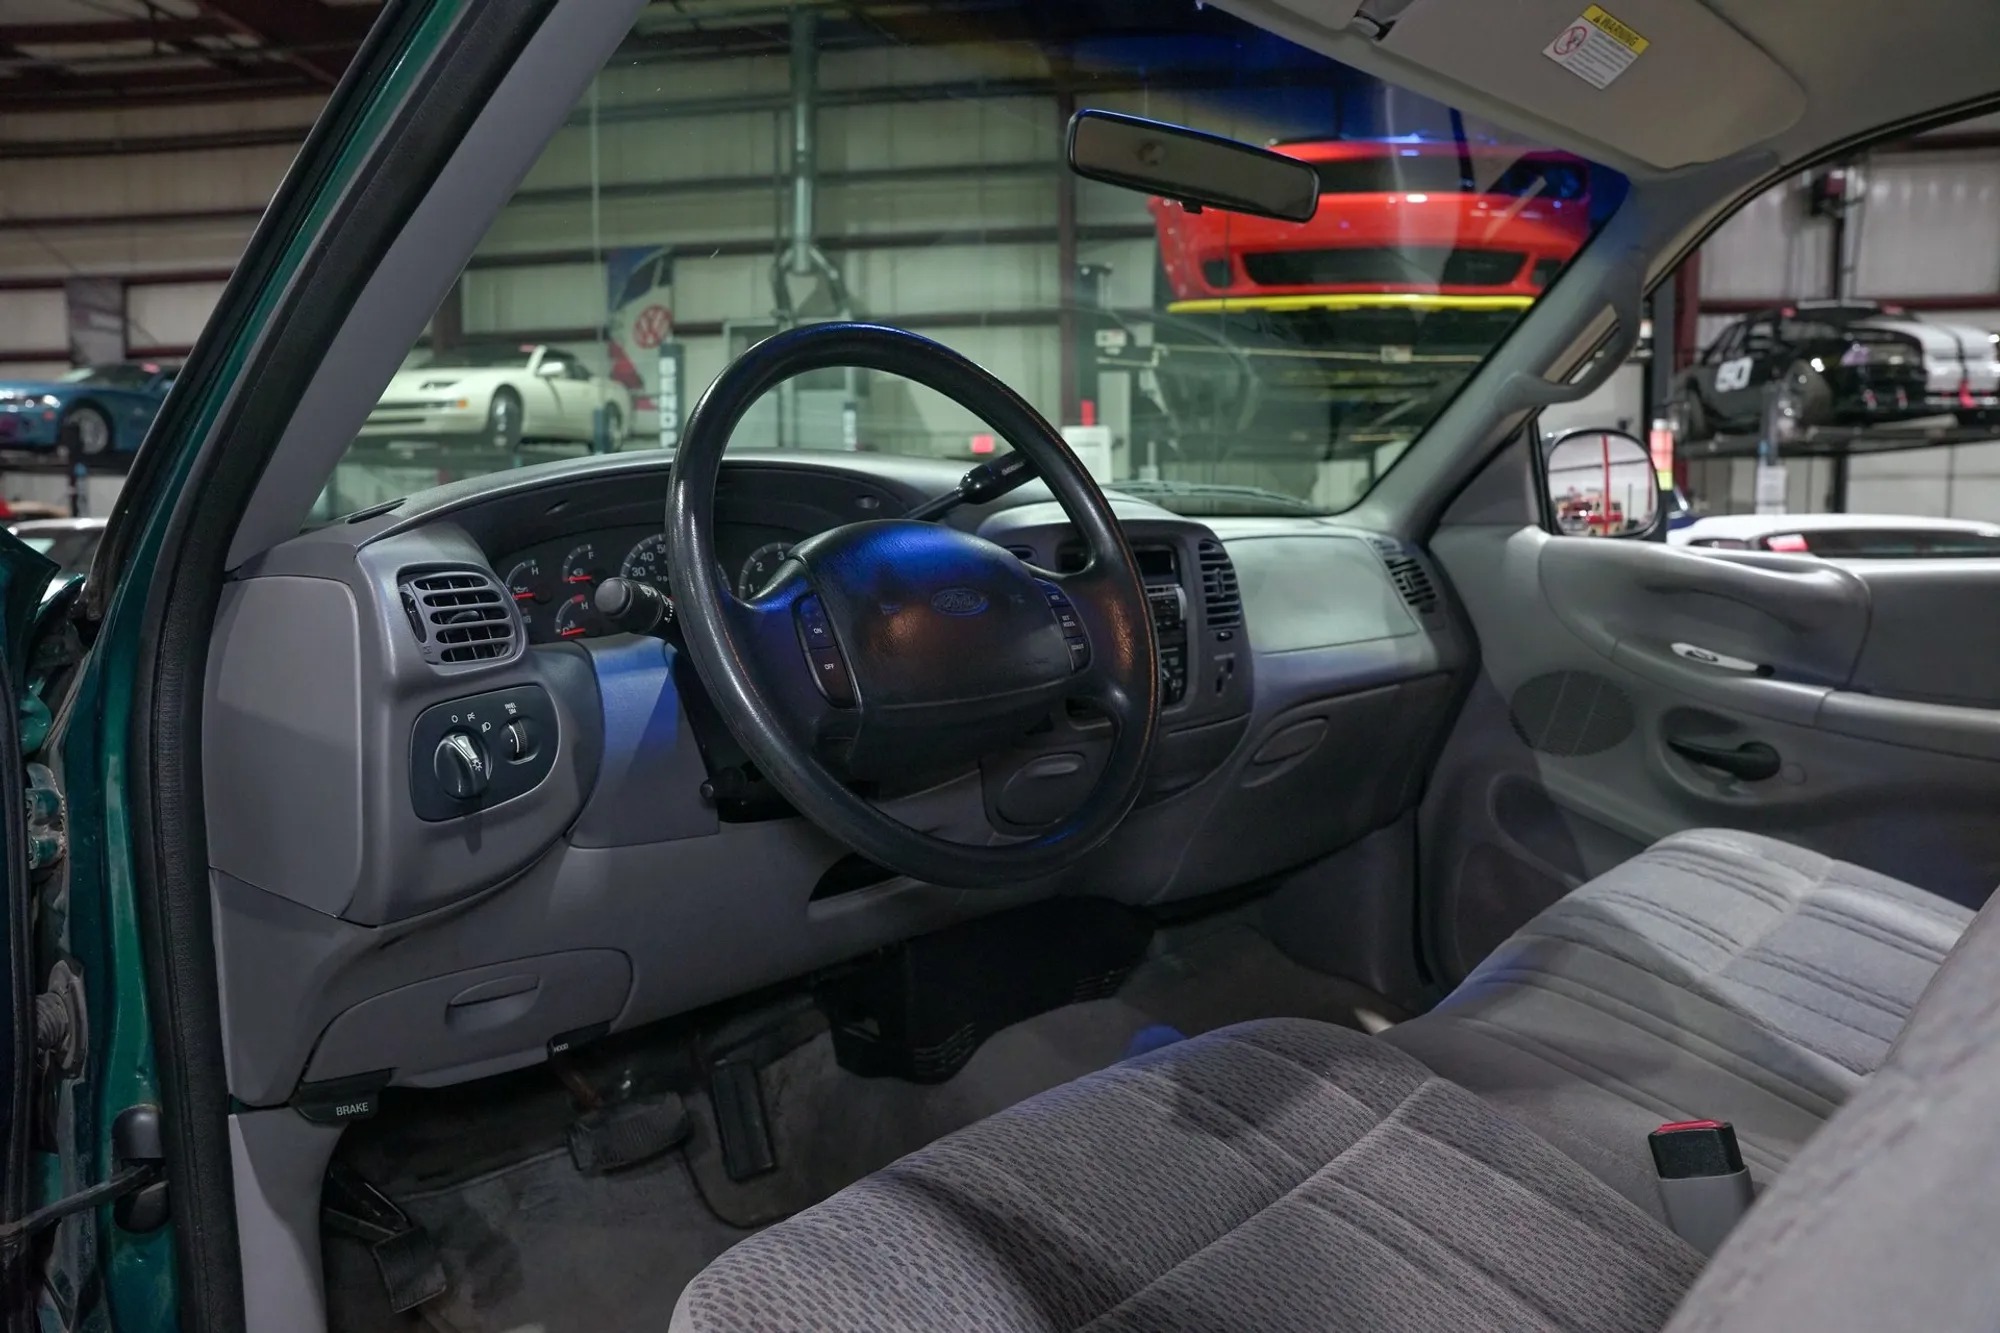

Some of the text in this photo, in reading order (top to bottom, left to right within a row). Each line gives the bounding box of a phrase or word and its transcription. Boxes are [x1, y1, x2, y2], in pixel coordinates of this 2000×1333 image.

[656, 544, 666, 554] 5
[588, 551, 594, 560] F
[640, 551, 654, 562] 40
[777, 551, 785, 561] 3
[531, 566, 539, 576] H
[631, 566, 646, 577] 30
[756, 561, 764, 572] 2
[580, 601, 589, 610] H
[336, 1102, 369, 1116] BRAKE
